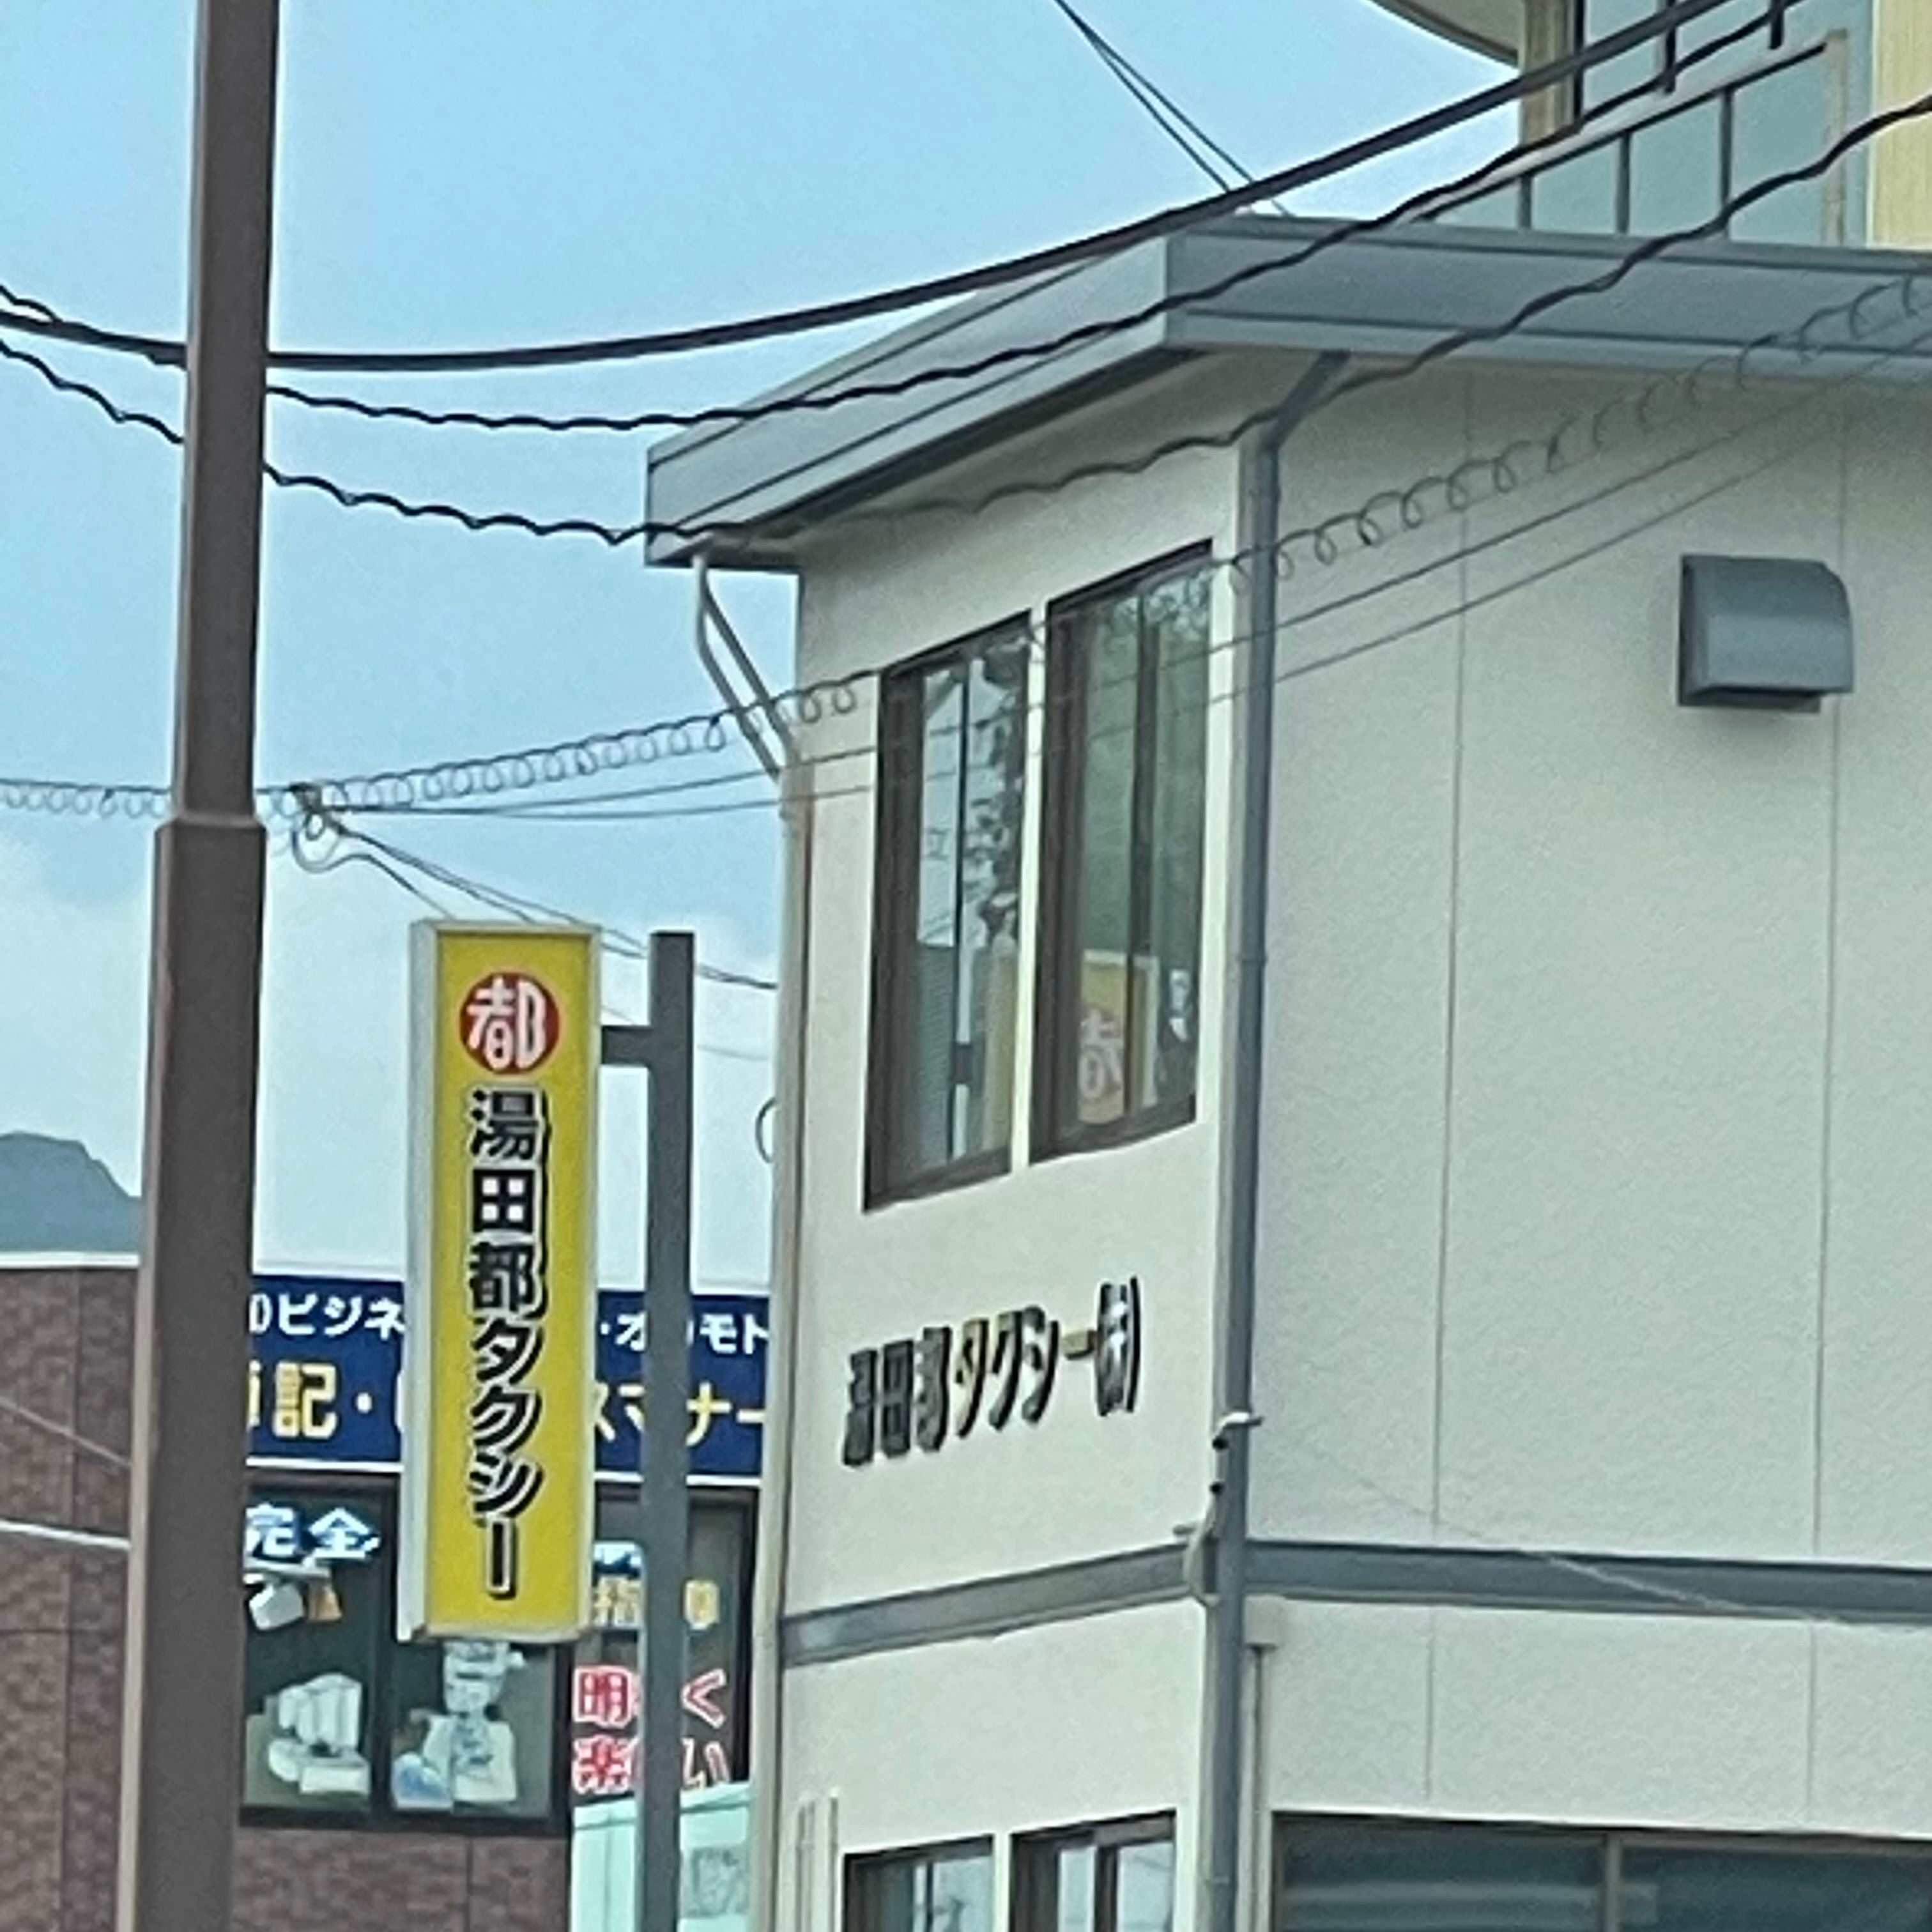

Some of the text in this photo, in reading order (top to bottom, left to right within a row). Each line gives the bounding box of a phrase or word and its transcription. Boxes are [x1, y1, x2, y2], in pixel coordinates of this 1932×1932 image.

[465, 975, 547, 1071] 都
[469, 1087, 551, 1597] 湯田都タクシー
[572, 1665, 727, 1729] 明く
